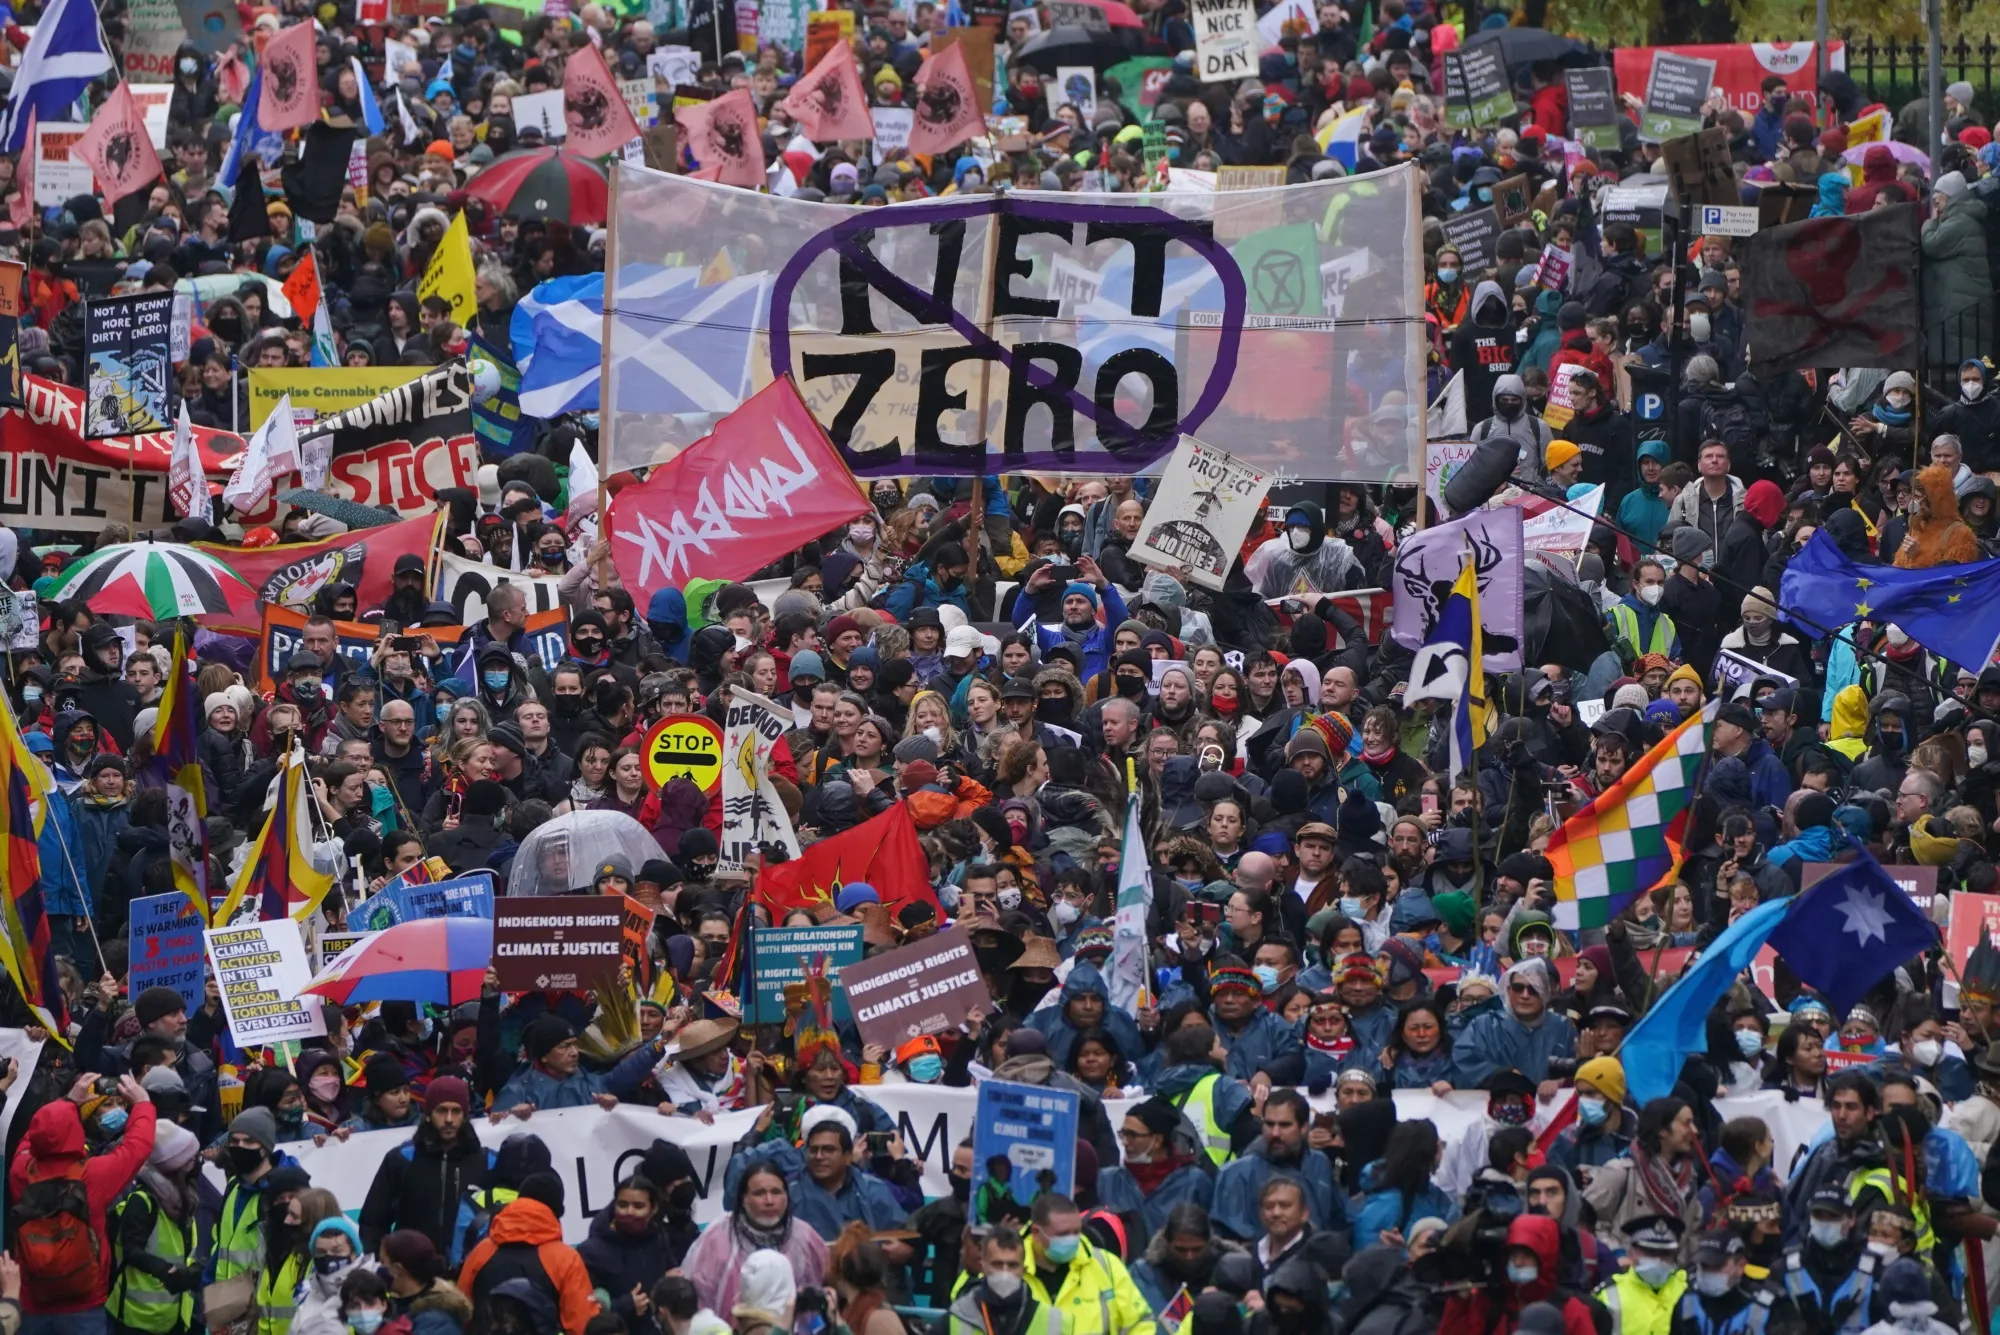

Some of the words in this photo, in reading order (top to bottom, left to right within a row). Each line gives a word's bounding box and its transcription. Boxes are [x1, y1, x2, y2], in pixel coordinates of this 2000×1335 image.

[1207, 52, 1249, 74] DAY
[1606, 212, 1641, 223] diversity
[1726, 211, 1736, 219] Pay
[1732, 217, 1756, 225] machine
[1447, 222, 1474, 236] There's
[1473, 218, 1484, 228] no
[1710, 226, 1732, 234] Display
[1459, 239, 1482, 253] ithout
[839, 215, 1214, 336] NET
[94, 306, 116, 318] NOT
[121, 304, 129, 314] A
[135, 298, 170, 313] PENNY
[102, 317, 132, 330] MORE
[138, 312, 161, 325] FOR
[1193, 313, 1222, 325] CODE
[1250, 316, 1272, 328] FOR
[1274, 318, 1333, 331] HUMANITY
[92, 331, 122, 344] DIRTY
[131, 324, 168, 340] ENERGY
[1475, 337, 1496, 348] THE
[254, 385, 310, 398] Legalise
[313, 385, 375, 396] Cannabis
[802, 341, 1179, 470] ZERO
[1202, 449, 1214, 460] WE
[1243, 467, 1254, 478] TO
[1426, 455, 1443, 476] NO
[1187, 453, 1257, 497] PROTECT
[1176, 520, 1211, 545] WATER
[1154, 532, 1179, 555] NO
[1177, 541, 1208, 567] LINE
[1203, 555, 1217, 572] 3
[1714, 654, 1743, 679] NO
[658, 733, 714, 752] STOP
[470, 884, 484, 896] THE
[153, 900, 180, 916] TIBET
[134, 927, 145, 937] IS
[146, 915, 200, 935] WARMING
[498, 916, 574, 928] INDIGENOUS
[575, 915, 620, 927] RIGHTS
[211, 929, 262, 946] TIBETAN
[765, 932, 792, 942] RIGHT
[793, 930, 858, 941] RELATIONSHIP
[146, 936, 160, 957] 3
[165, 935, 194, 949] TIMES
[214, 940, 268, 958] CLIMATE
[497, 942, 559, 957] CLIMATE
[561, 942, 620, 955] JUSTICE
[757, 944, 780, 954] WITH
[781, 943, 837, 953] INDIGENOUS
[838, 942, 854, 951] KIN
[132, 958, 169, 973] FASTER
[172, 952, 200, 967] THAN
[219, 952, 281, 970] ACTIVISTS
[849, 958, 924, 996] INDIGENOUS
[925, 944, 970, 970] RIGHTS
[136, 979, 155, 992] THE
[156, 974, 183, 987] REST
[183, 970, 198, 983] OF
[221, 972, 236, 983] IN
[237, 966, 272, 980] TIBET
[764, 968, 790, 978] RIGHT
[226, 981, 258, 995] FACE
[858, 989, 922, 1023] CLIMATE
[922, 969, 979, 1001] JUSTICE
[232, 1001, 287, 1020] TORTURE
[290, 999, 301, 1011] &
[235, 1019, 268, 1033] EVEN
[270, 1012, 312, 1028] DEATH
